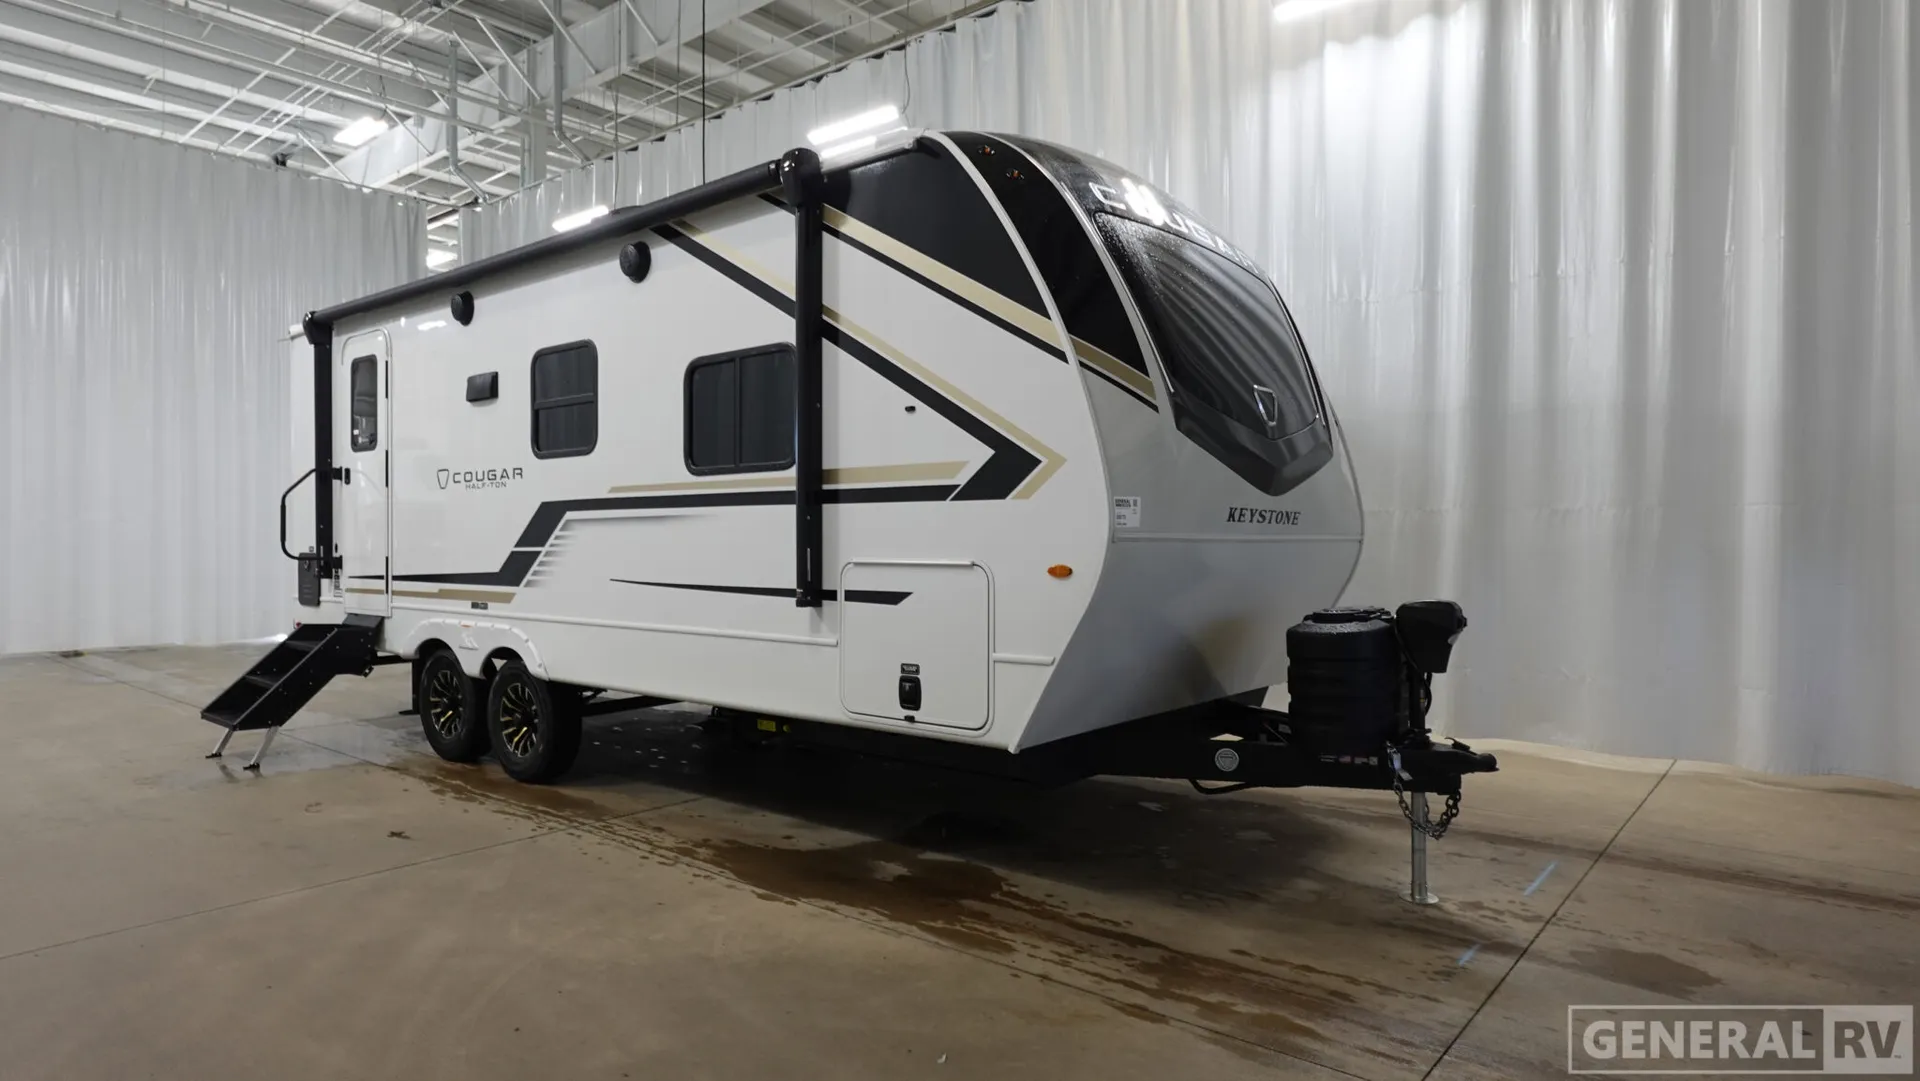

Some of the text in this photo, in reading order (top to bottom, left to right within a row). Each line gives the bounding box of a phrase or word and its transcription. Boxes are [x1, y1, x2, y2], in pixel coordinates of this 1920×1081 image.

[1089, 177, 1259, 274] CUGAR
[453, 467, 524, 484] COUGAR
[465, 481, 507, 490] HALF-TON
[1226, 507, 1301, 526] KEYSTONE
